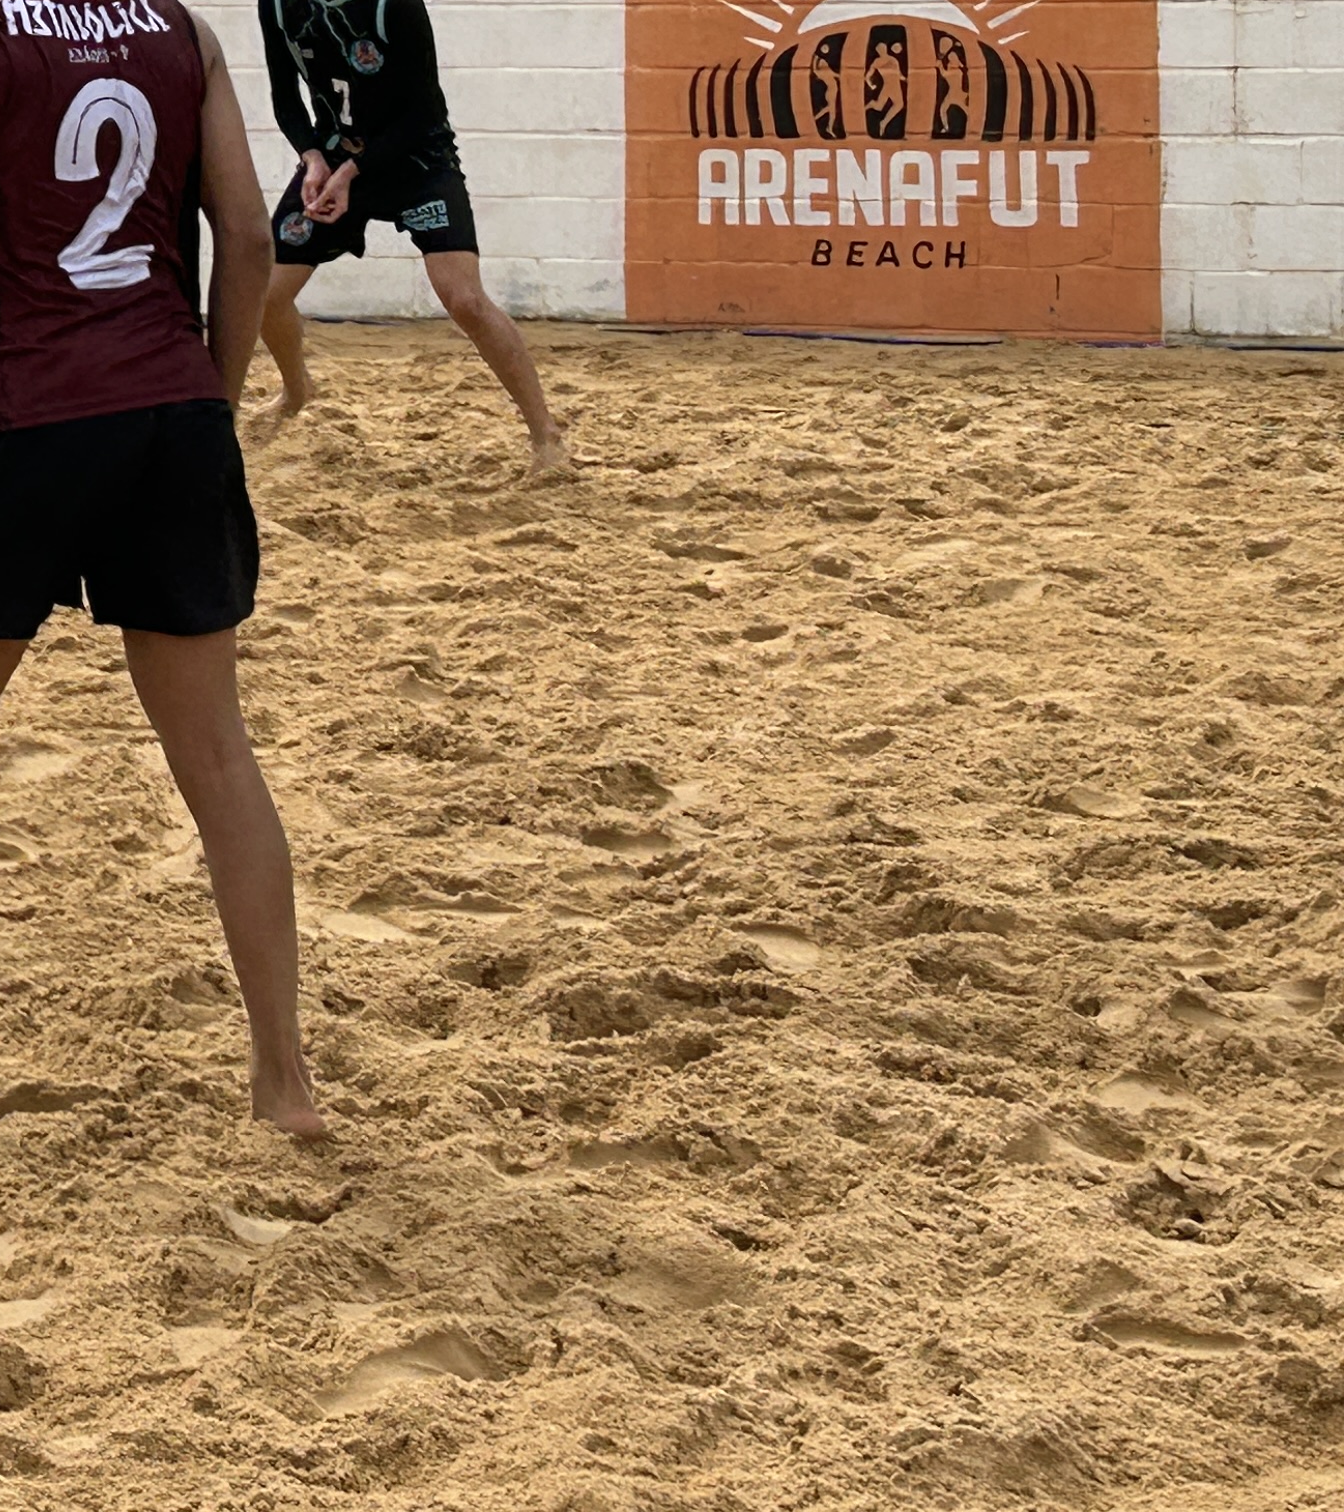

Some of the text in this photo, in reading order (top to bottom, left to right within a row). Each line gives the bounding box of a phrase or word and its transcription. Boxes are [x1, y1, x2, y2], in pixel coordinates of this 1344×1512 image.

[331, 78, 353, 126] 7
[55, 78, 157, 289] 2
[697, 148, 1090, 227] ARENAFUT
[811, 239, 967, 270] BEACH
